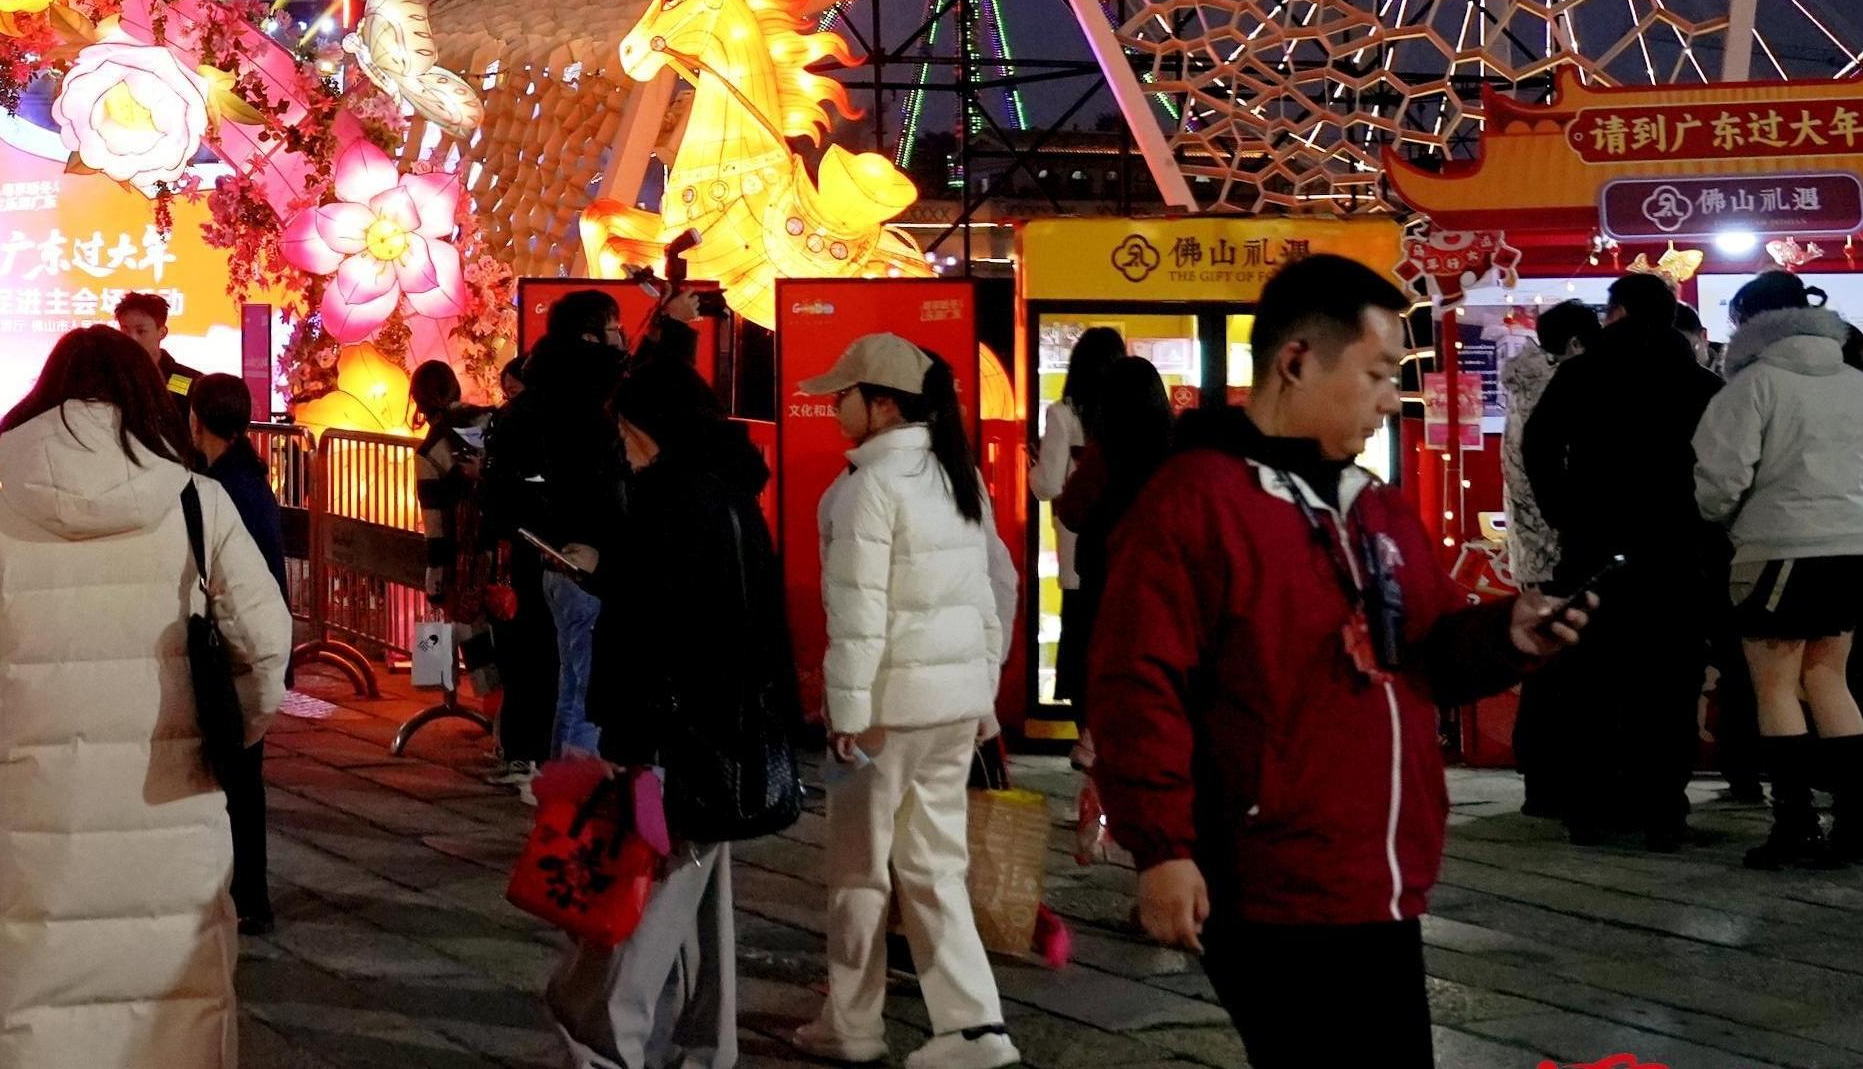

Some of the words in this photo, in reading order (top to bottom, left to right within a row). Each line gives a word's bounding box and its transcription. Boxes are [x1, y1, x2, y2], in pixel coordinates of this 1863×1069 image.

[1589, 106, 1863, 155] 请到广东过大年
[1168, 271, 1195, 281] THE
[1199, 271, 1232, 282] GIFT
[1237, 271, 1254, 281] OF
